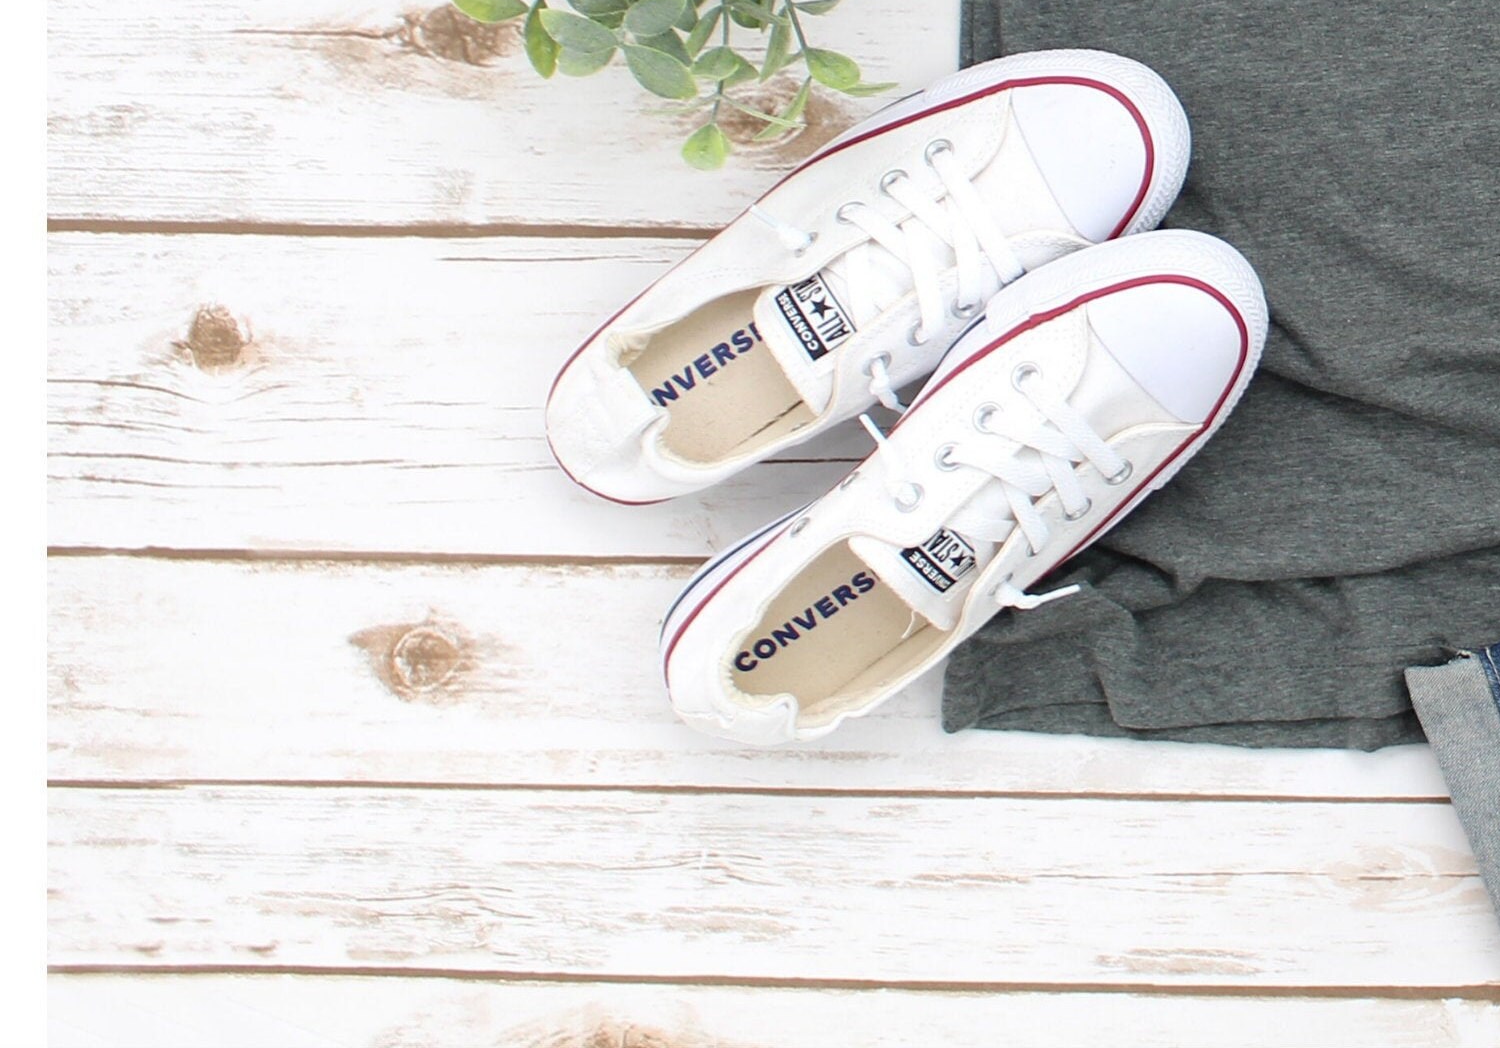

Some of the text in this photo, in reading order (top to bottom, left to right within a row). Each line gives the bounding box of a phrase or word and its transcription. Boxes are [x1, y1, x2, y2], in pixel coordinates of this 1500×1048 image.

[648, 320, 763, 408] NVERS
[816, 310, 851, 343] ALL
[733, 568, 880, 673] CONVERS
